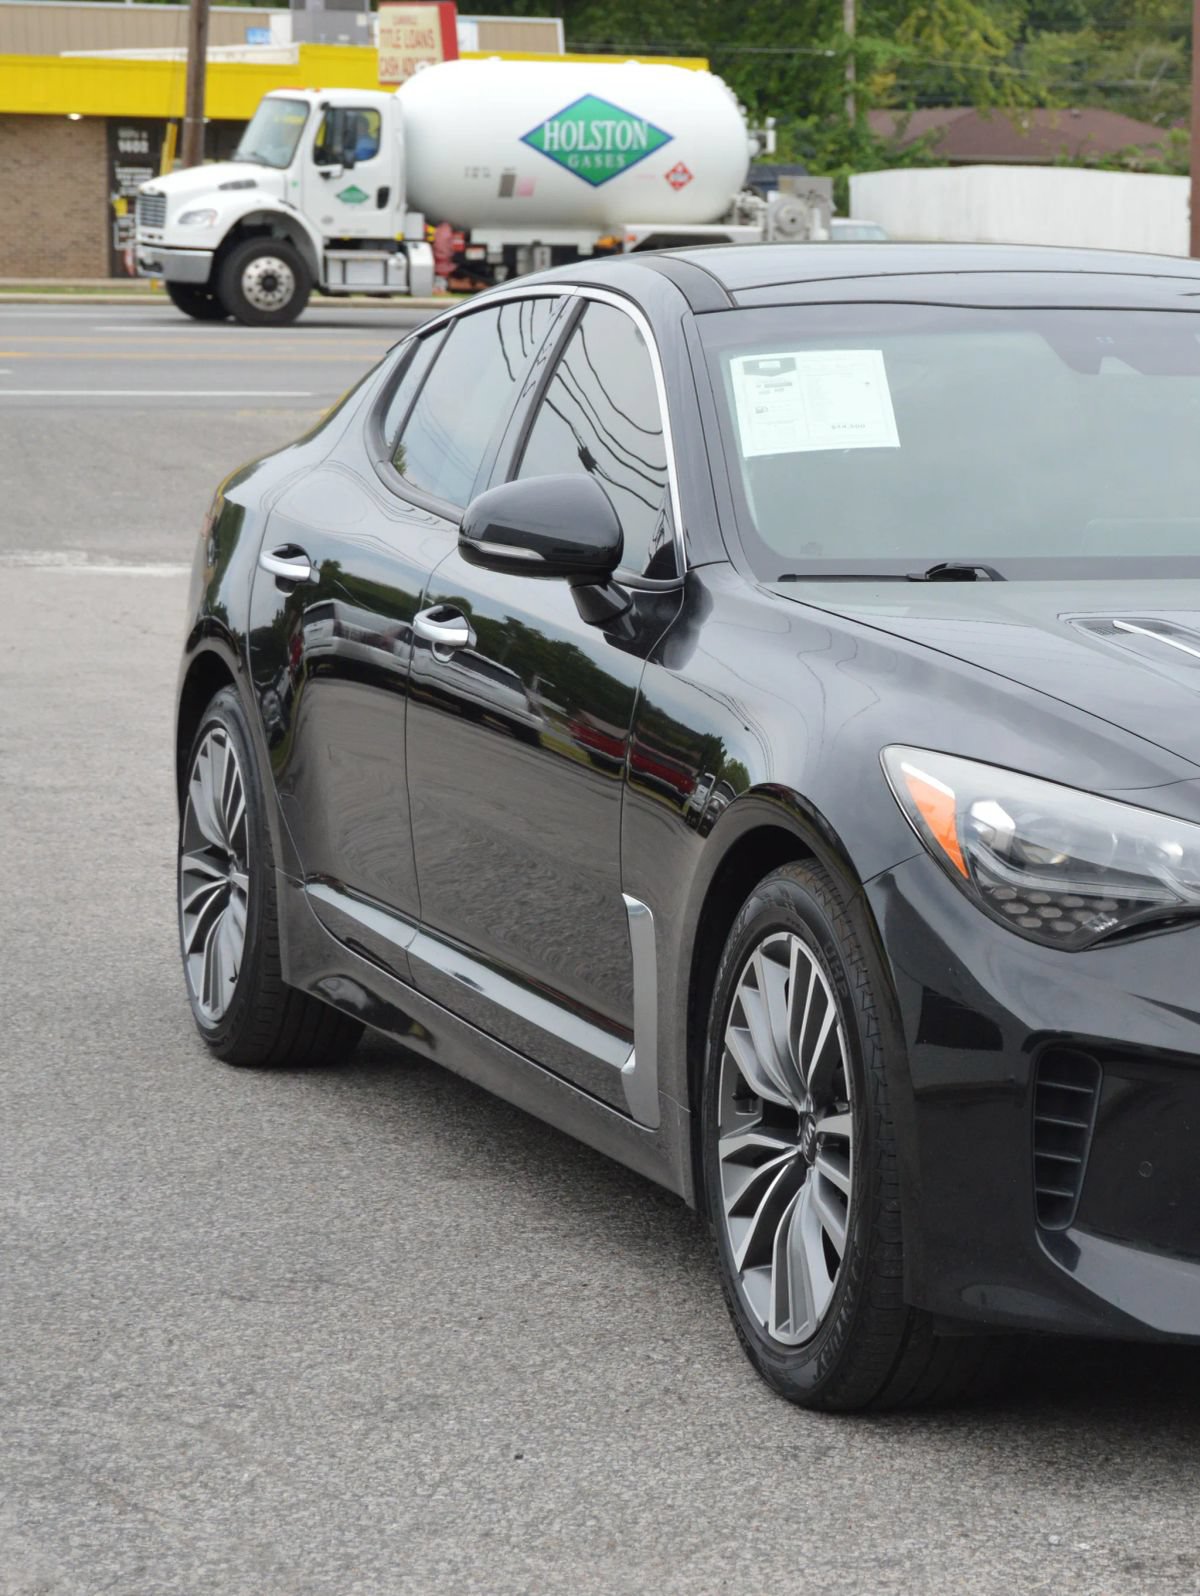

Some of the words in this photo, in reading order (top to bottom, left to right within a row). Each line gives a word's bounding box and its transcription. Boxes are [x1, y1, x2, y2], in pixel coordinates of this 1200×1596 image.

[380, 28, 401, 48] TITLE
[404, 28, 435, 48] LOANS
[543, 119, 648, 152] HOLSTON
[567, 153, 626, 169] GASES
